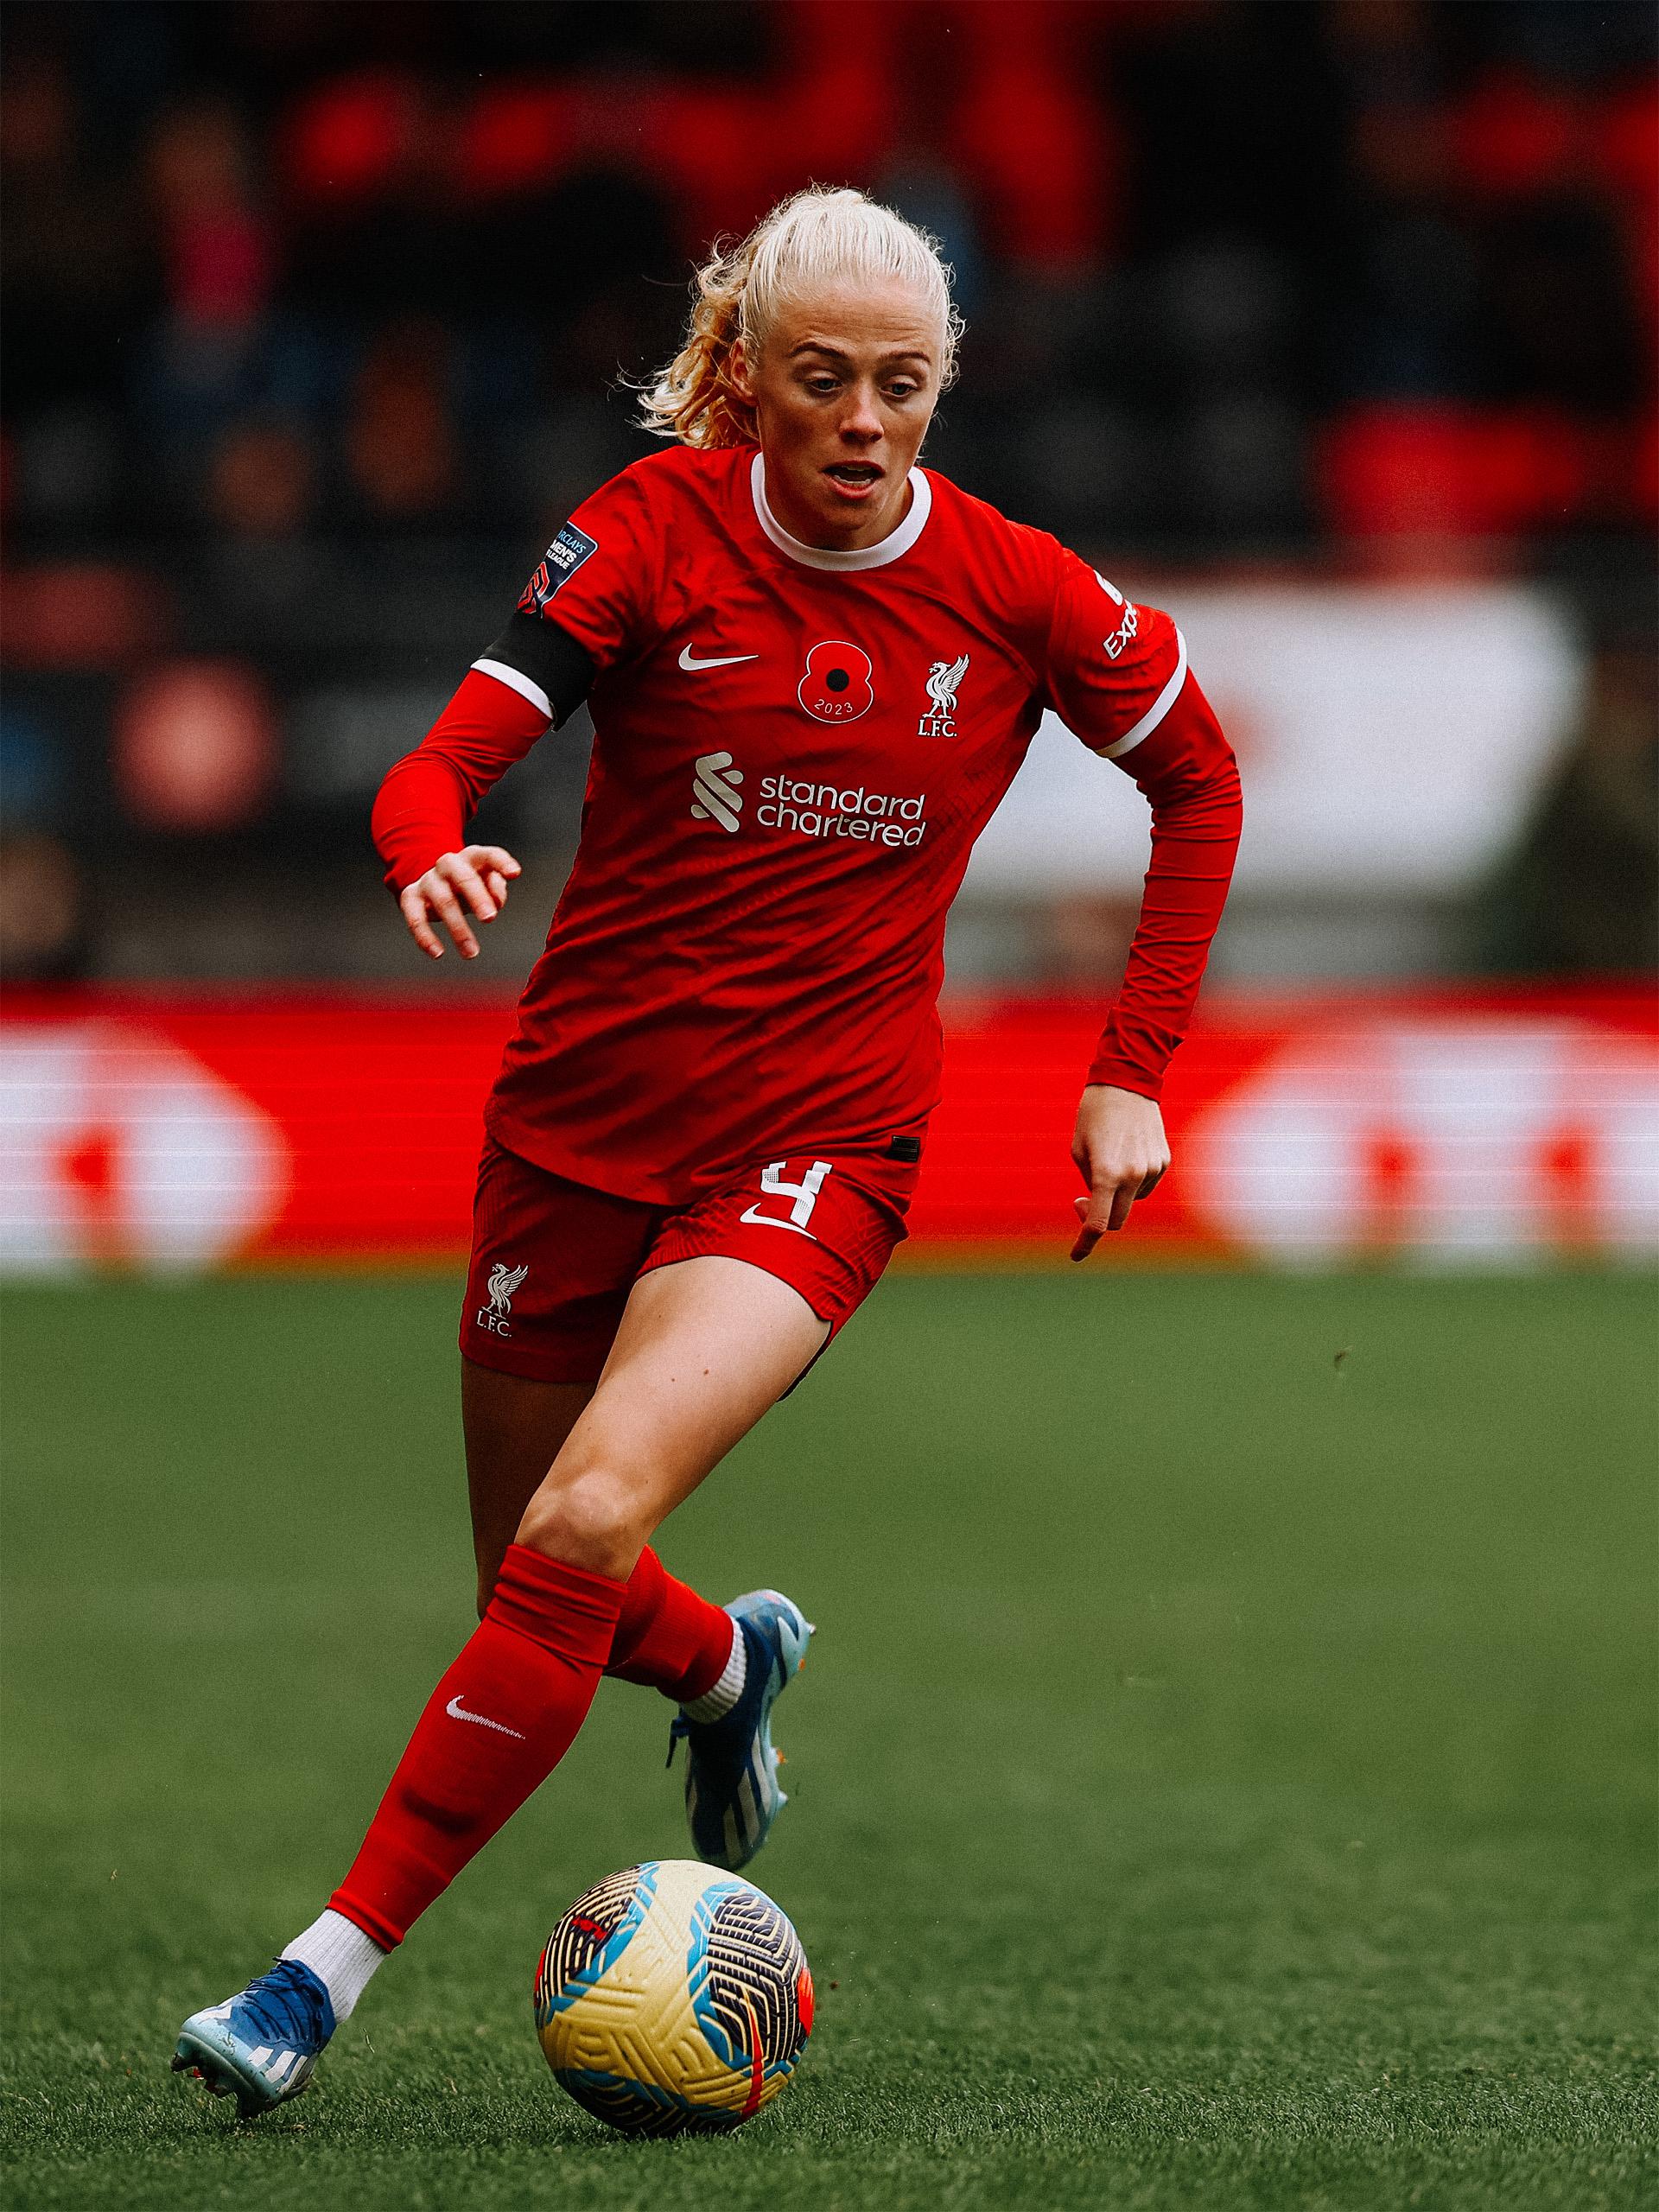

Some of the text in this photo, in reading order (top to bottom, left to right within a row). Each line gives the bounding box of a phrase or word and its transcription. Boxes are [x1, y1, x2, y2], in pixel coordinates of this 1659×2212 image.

[814, 698, 853, 715] 2023
[918, 719, 957, 737] L.F.C.
[760, 774, 925, 820] standard
[757, 801, 926, 847] chartered
[760, 1160, 833, 1230] 4
[476, 1310, 512, 1338] L.F.C.
